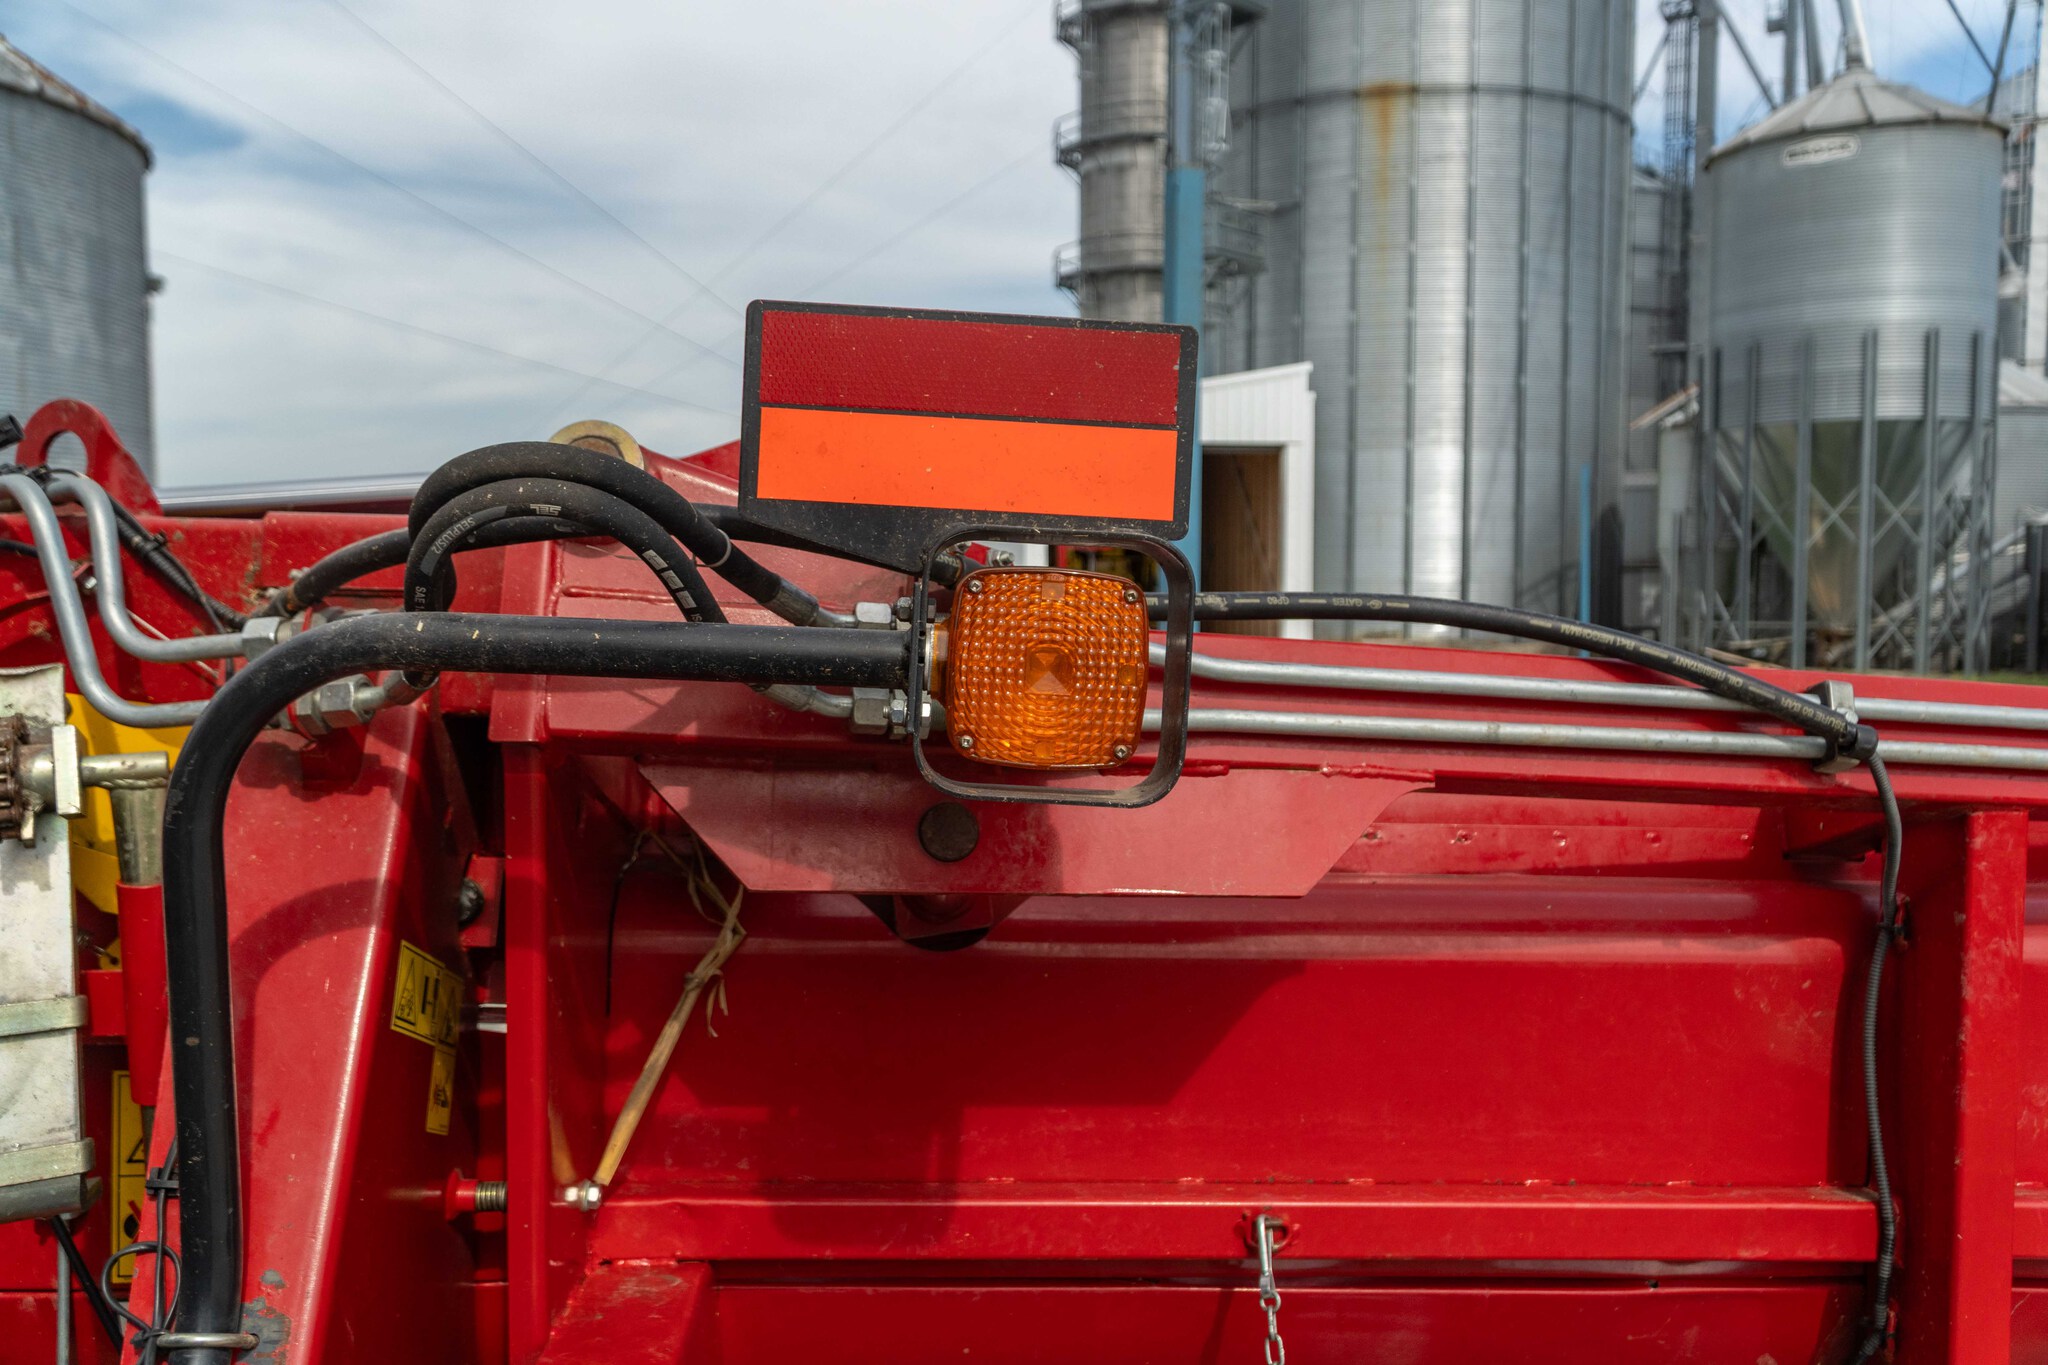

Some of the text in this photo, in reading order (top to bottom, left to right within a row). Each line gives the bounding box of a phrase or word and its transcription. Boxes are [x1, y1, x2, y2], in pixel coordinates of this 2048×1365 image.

[530, 503, 562, 516] SEL
[430, 517, 476, 554] SELPLUS/2
[415, 586, 426, 603] SAE
[1332, 597, 1363, 608] GATES
[1673, 655, 1743, 688] OIL RESISTANT
[1780, 696, 1802, 712] BAR
